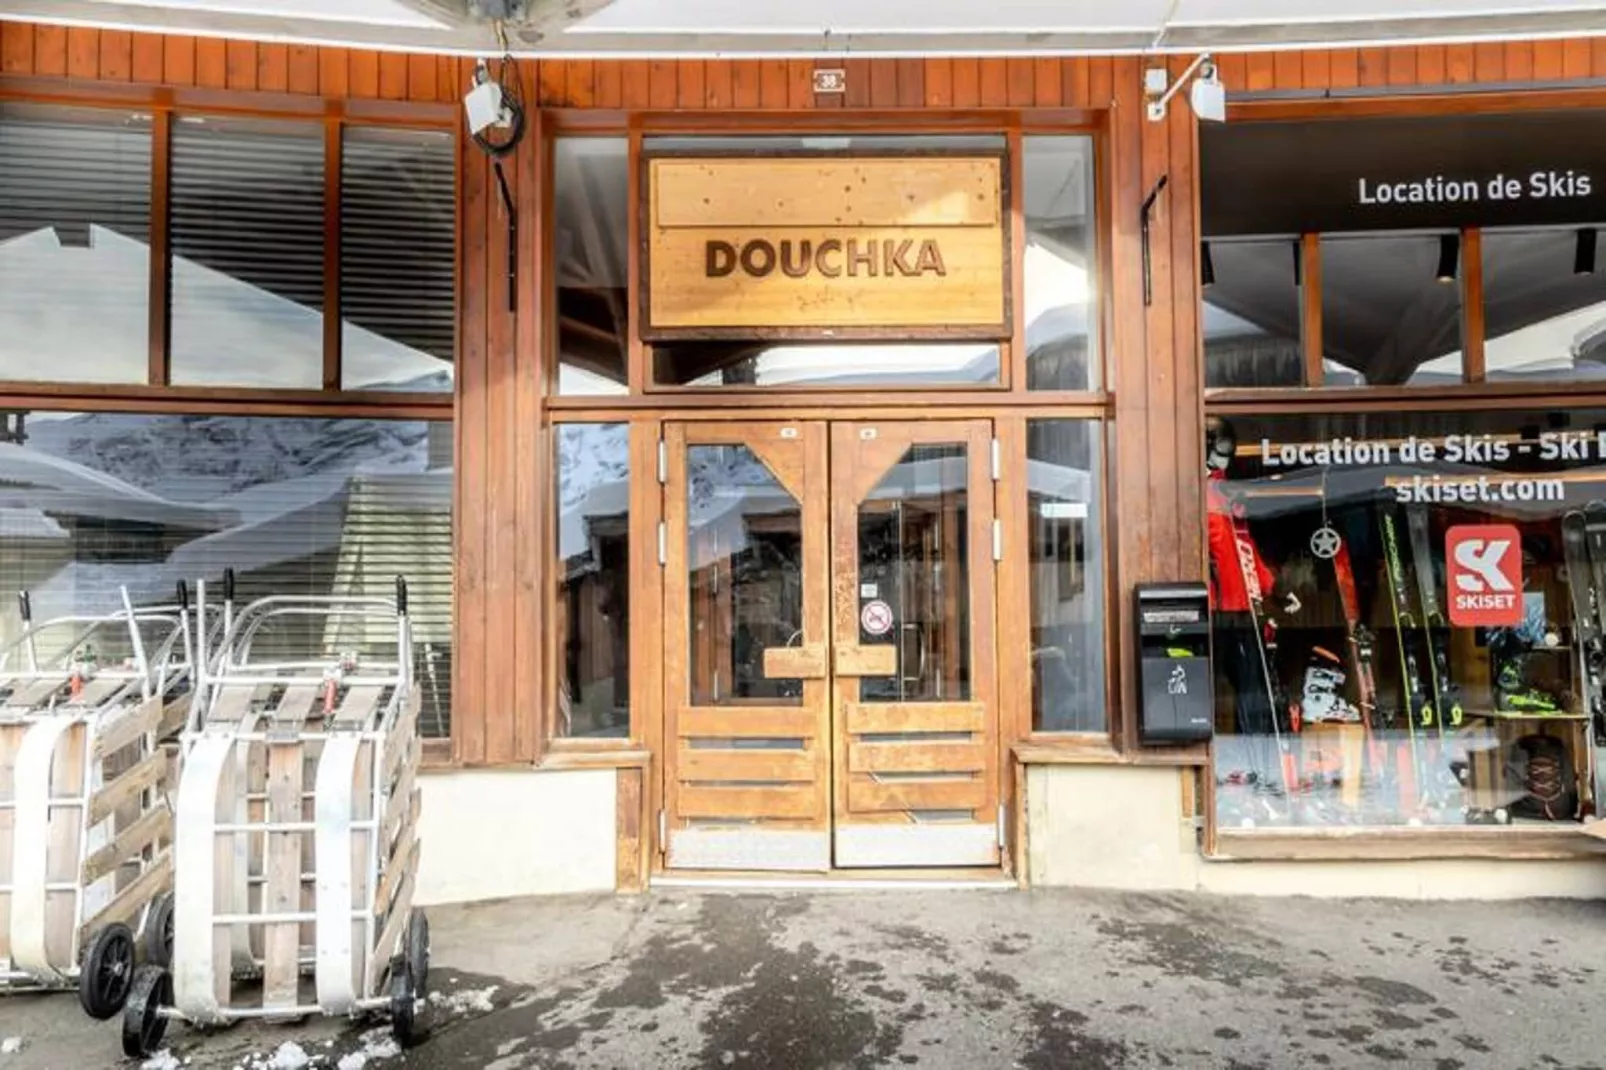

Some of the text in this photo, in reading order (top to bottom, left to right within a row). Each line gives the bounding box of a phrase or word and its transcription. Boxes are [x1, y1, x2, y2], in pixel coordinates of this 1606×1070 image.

[1358, 170, 1591, 204] Location de Skis
[705, 238, 946, 278] DOUCHKA
[1261, 437, 1390, 466] Location
[1399, 435, 1436, 463] de
[1444, 434, 1511, 462] Skis
[1518, 445, 1531, 454] -
[1539, 431, 1589, 460] Ski
[1396, 475, 1565, 503] skiset.com
[1456, 594, 1516, 610] SKISET
